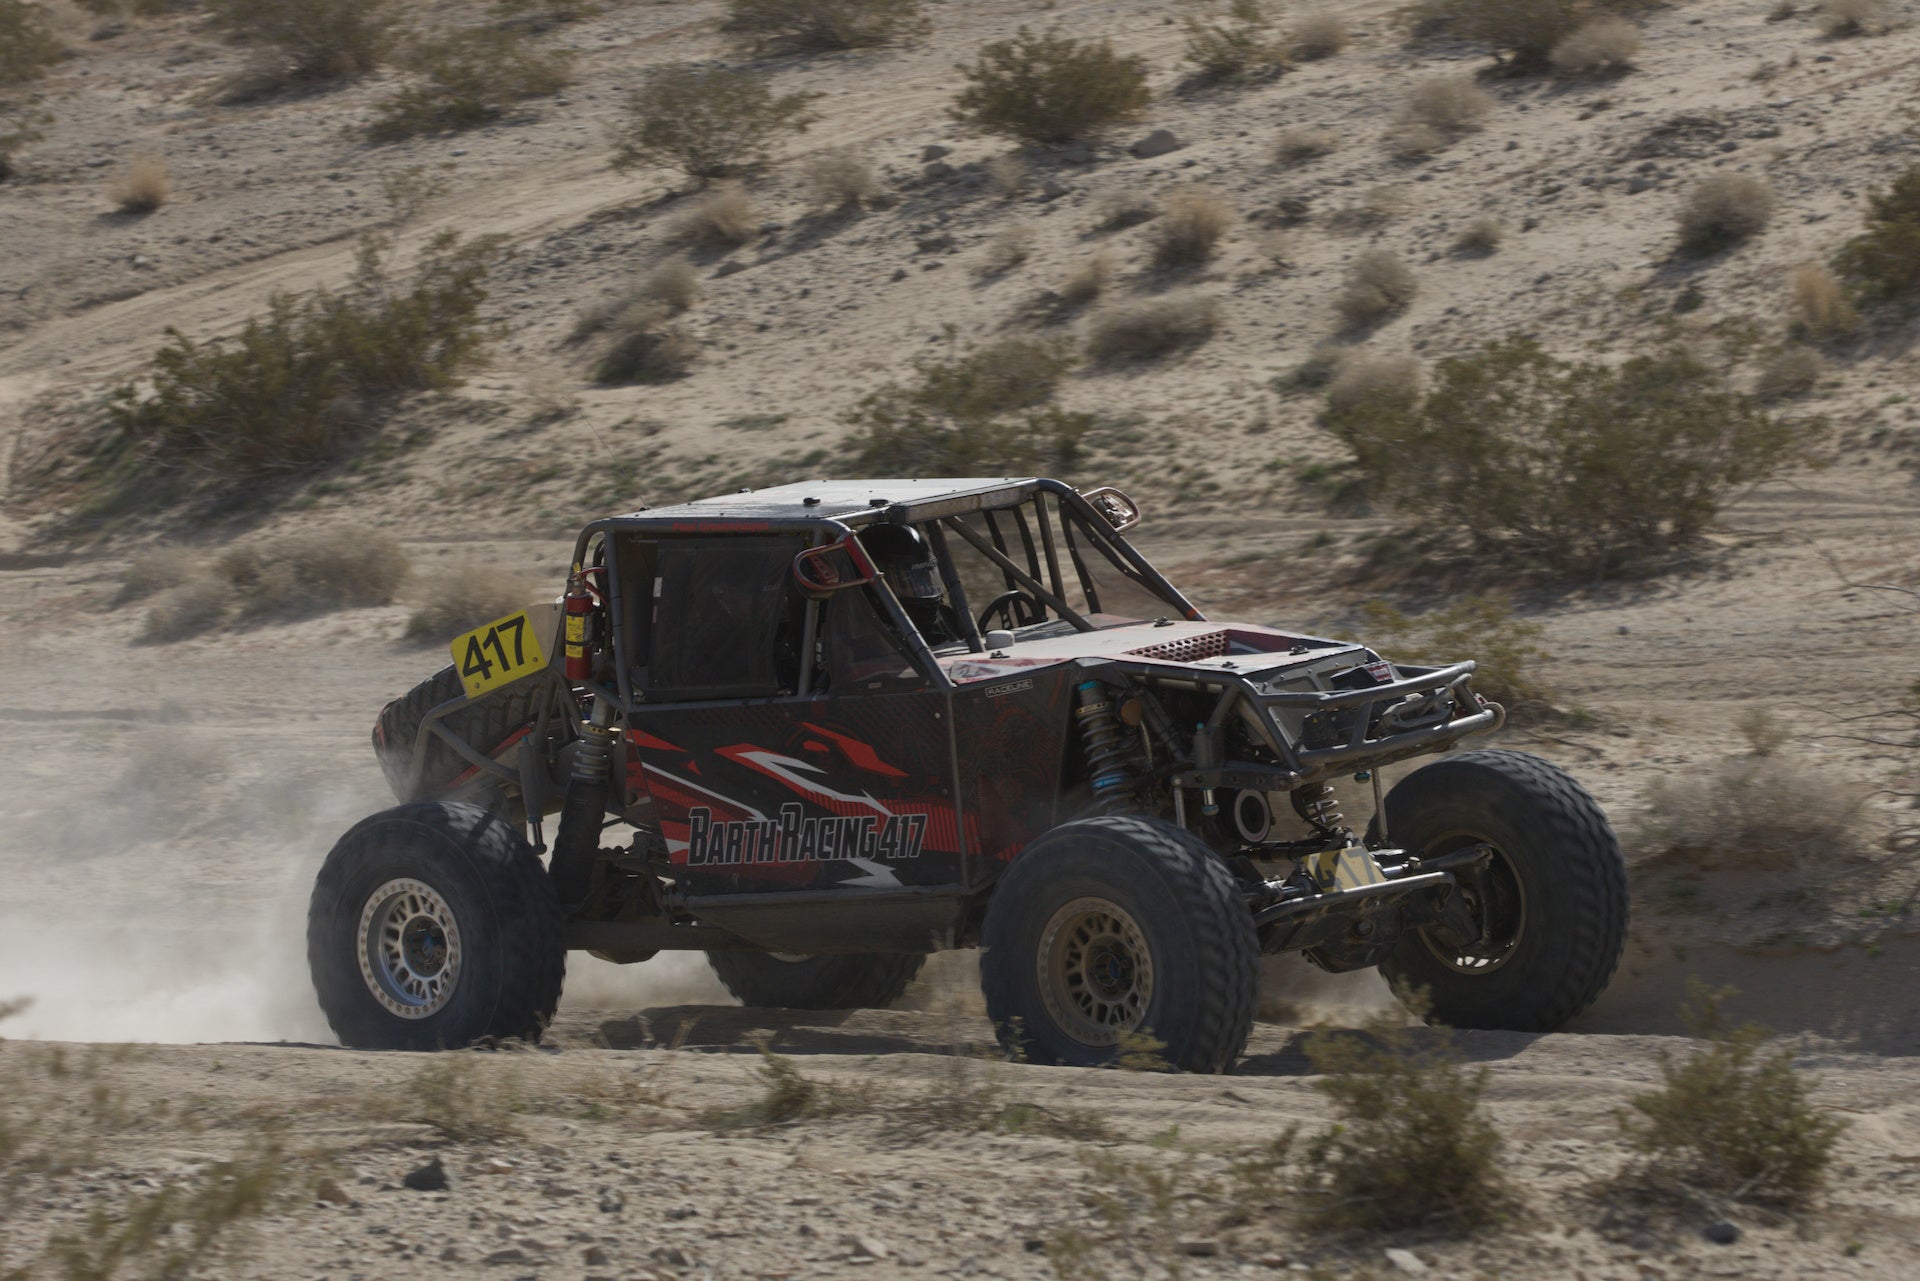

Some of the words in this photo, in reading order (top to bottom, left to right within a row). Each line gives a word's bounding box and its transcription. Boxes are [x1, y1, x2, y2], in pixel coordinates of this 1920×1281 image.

[463, 615, 525, 680] 417
[987, 680, 1031, 696] RACELINE
[878, 813, 927, 859] 417
